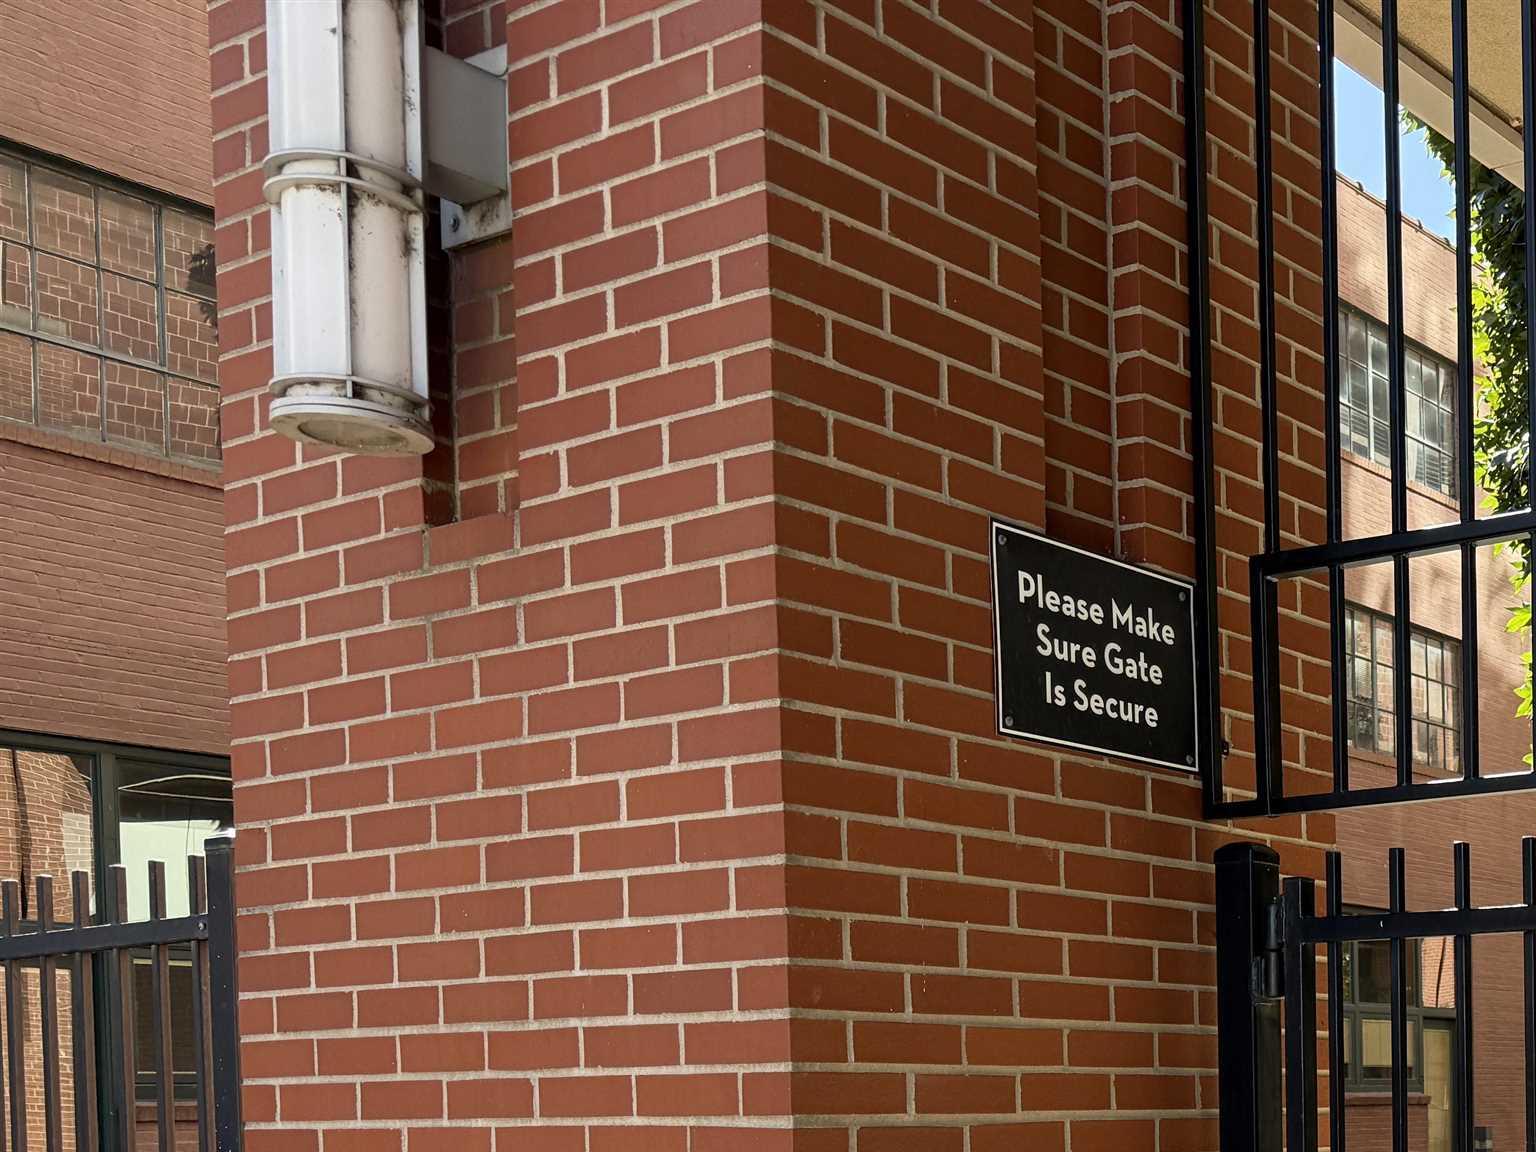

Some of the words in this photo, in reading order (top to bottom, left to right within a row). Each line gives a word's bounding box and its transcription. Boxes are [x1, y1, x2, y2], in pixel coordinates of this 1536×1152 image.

[1017, 570, 1105, 625] Please
[1111, 597, 1175, 646] Make
[1036, 623, 1097, 668] Sure
[1104, 642, 1163, 685] Gate
[1045, 671, 1066, 707] Is
[1073, 678, 1159, 728] Secure
